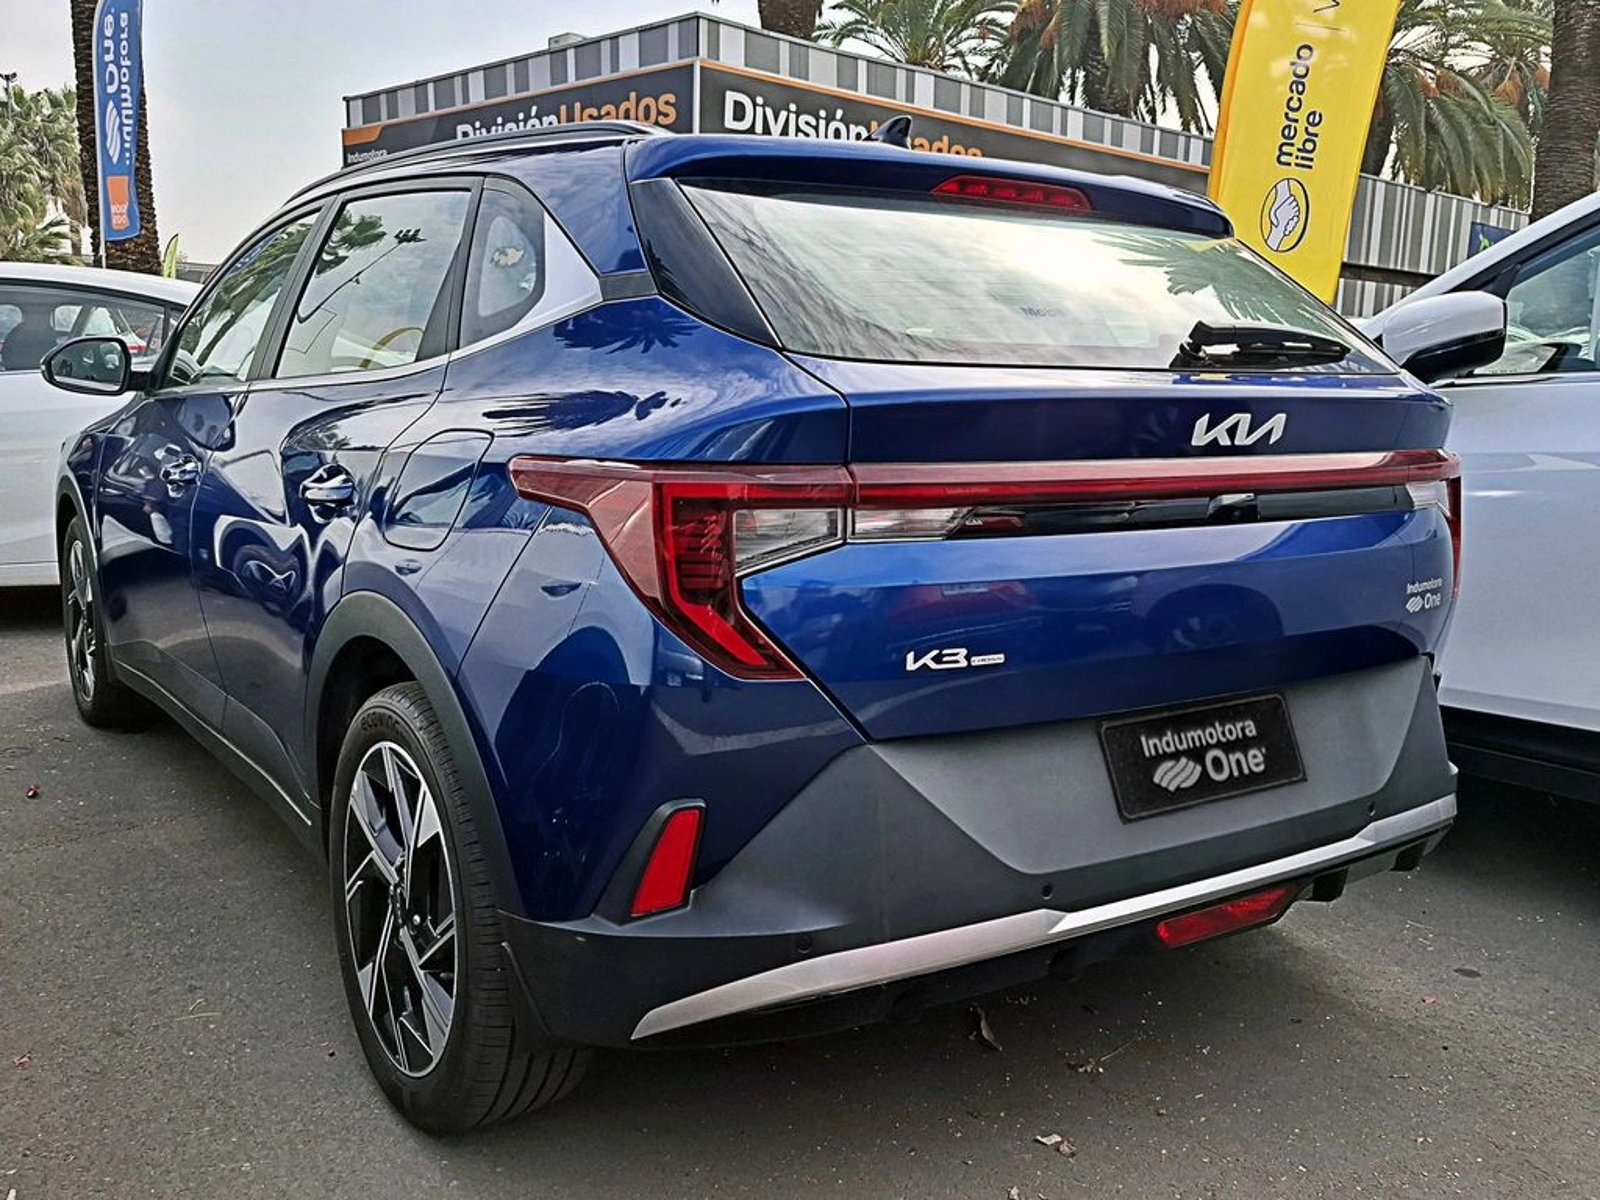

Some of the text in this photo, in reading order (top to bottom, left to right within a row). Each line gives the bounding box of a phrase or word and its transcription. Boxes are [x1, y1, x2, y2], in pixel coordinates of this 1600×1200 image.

[1276, 43, 1315, 168] mercado
[1294, 110, 1323, 170] libre
[1190, 412, 1288, 446] KIA
[1424, 592, 1442, 609] One
[905, 647, 969, 671] K3
[1140, 719, 1258, 758] Indumotora
[1204, 747, 1266, 783] One
